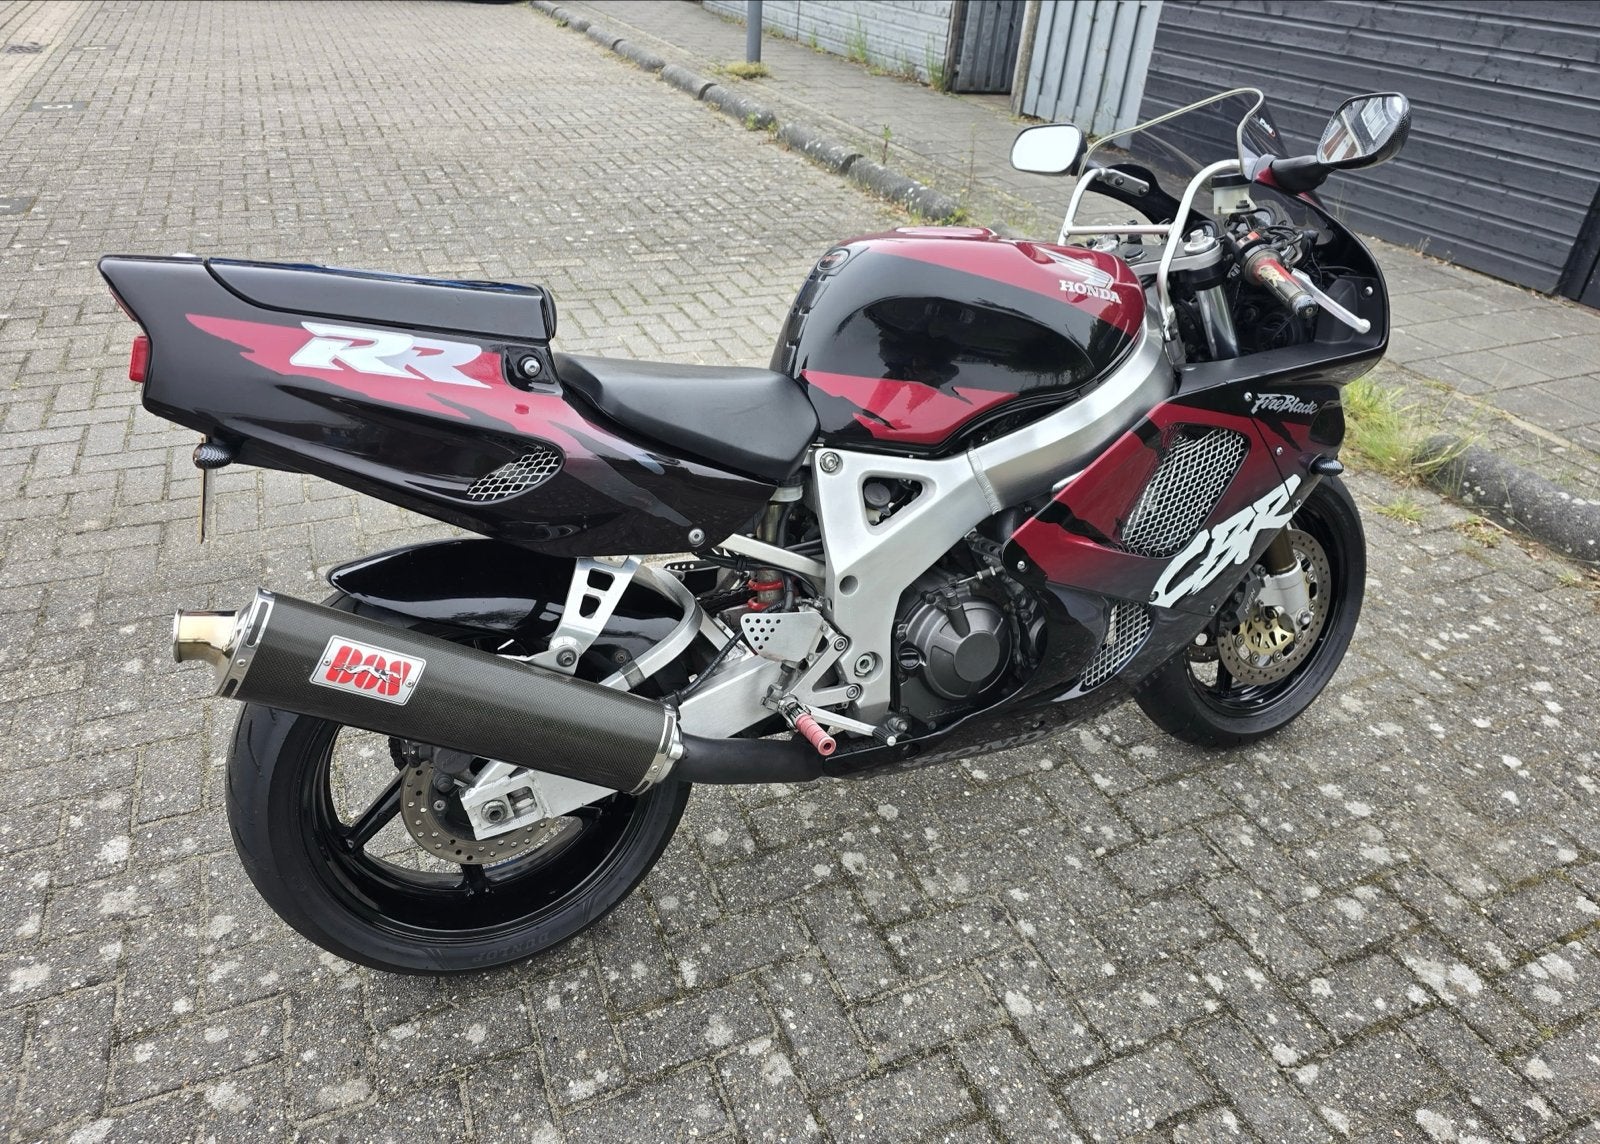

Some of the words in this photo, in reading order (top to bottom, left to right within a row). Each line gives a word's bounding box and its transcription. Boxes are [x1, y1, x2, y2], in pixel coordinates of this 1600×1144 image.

[1059, 280, 1122, 304] HONDA
[289, 321, 493, 389] RR
[1149, 474, 1301, 608] CBR
[325, 645, 412, 696] BOS
[472, 931, 551, 962] DUNLOP
